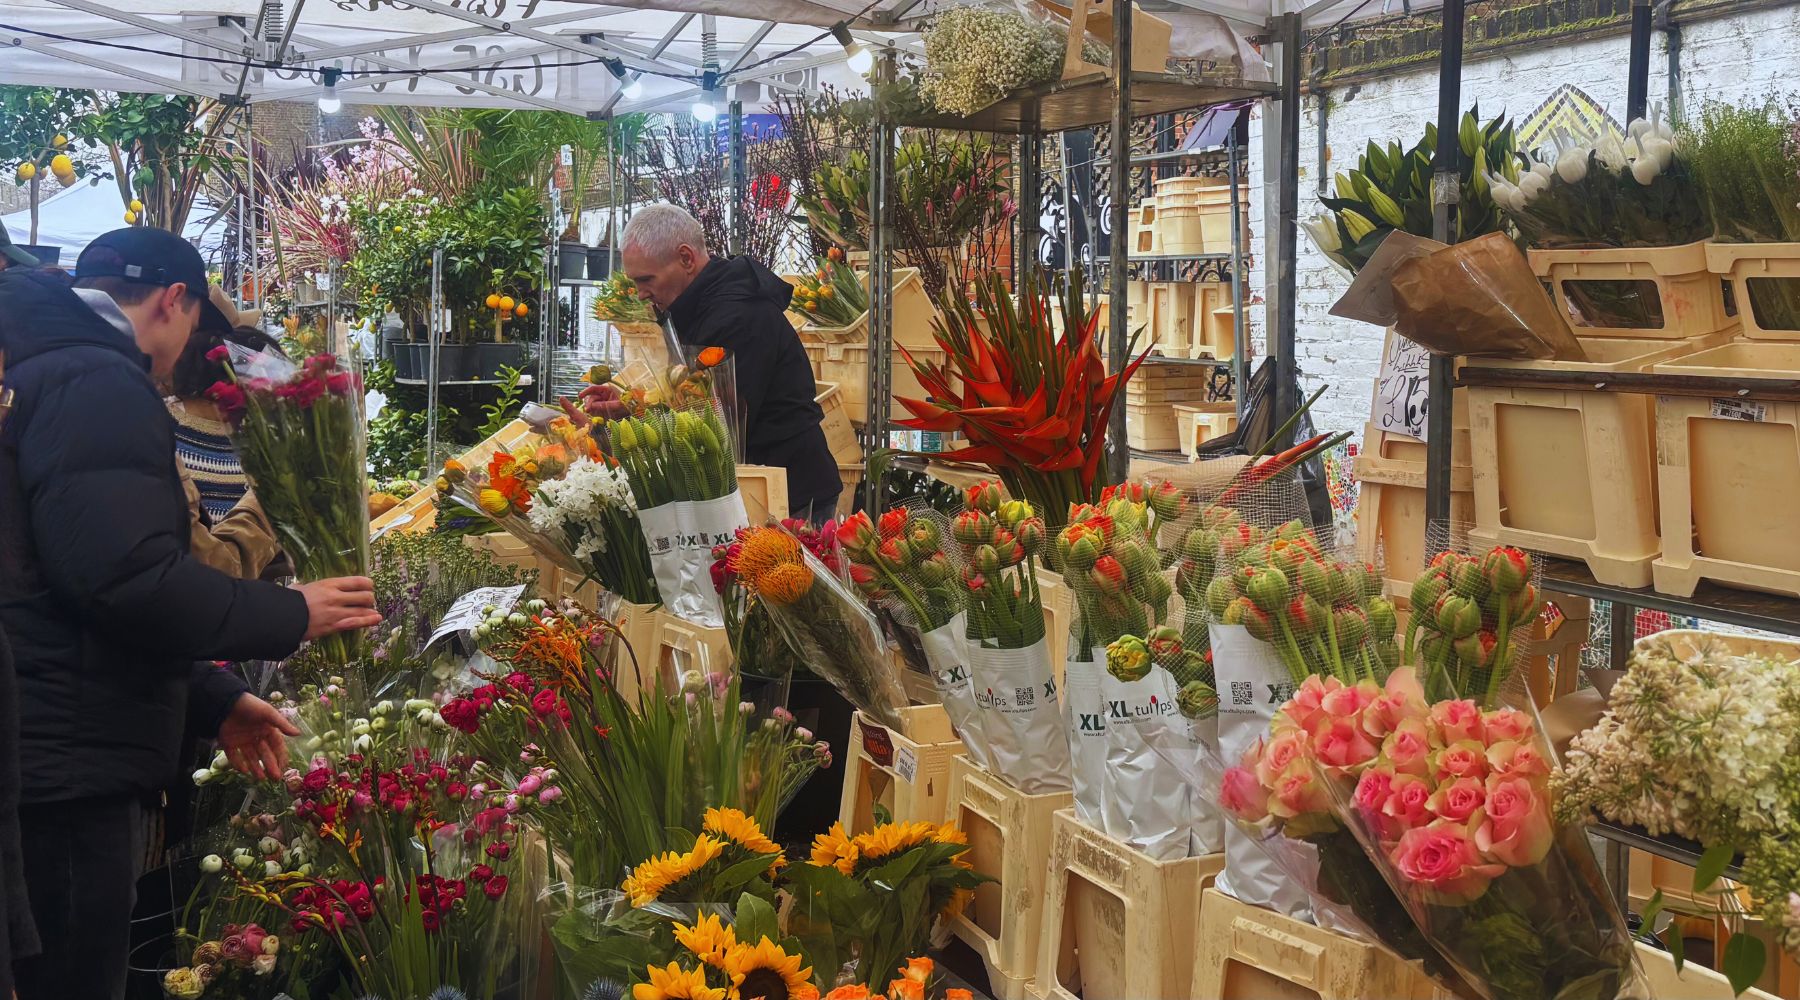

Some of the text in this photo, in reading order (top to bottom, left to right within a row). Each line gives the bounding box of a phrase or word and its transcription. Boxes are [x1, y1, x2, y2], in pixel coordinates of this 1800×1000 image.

[1108, 695, 1172, 718] XL tulips
[1080, 713, 1105, 731] XL
